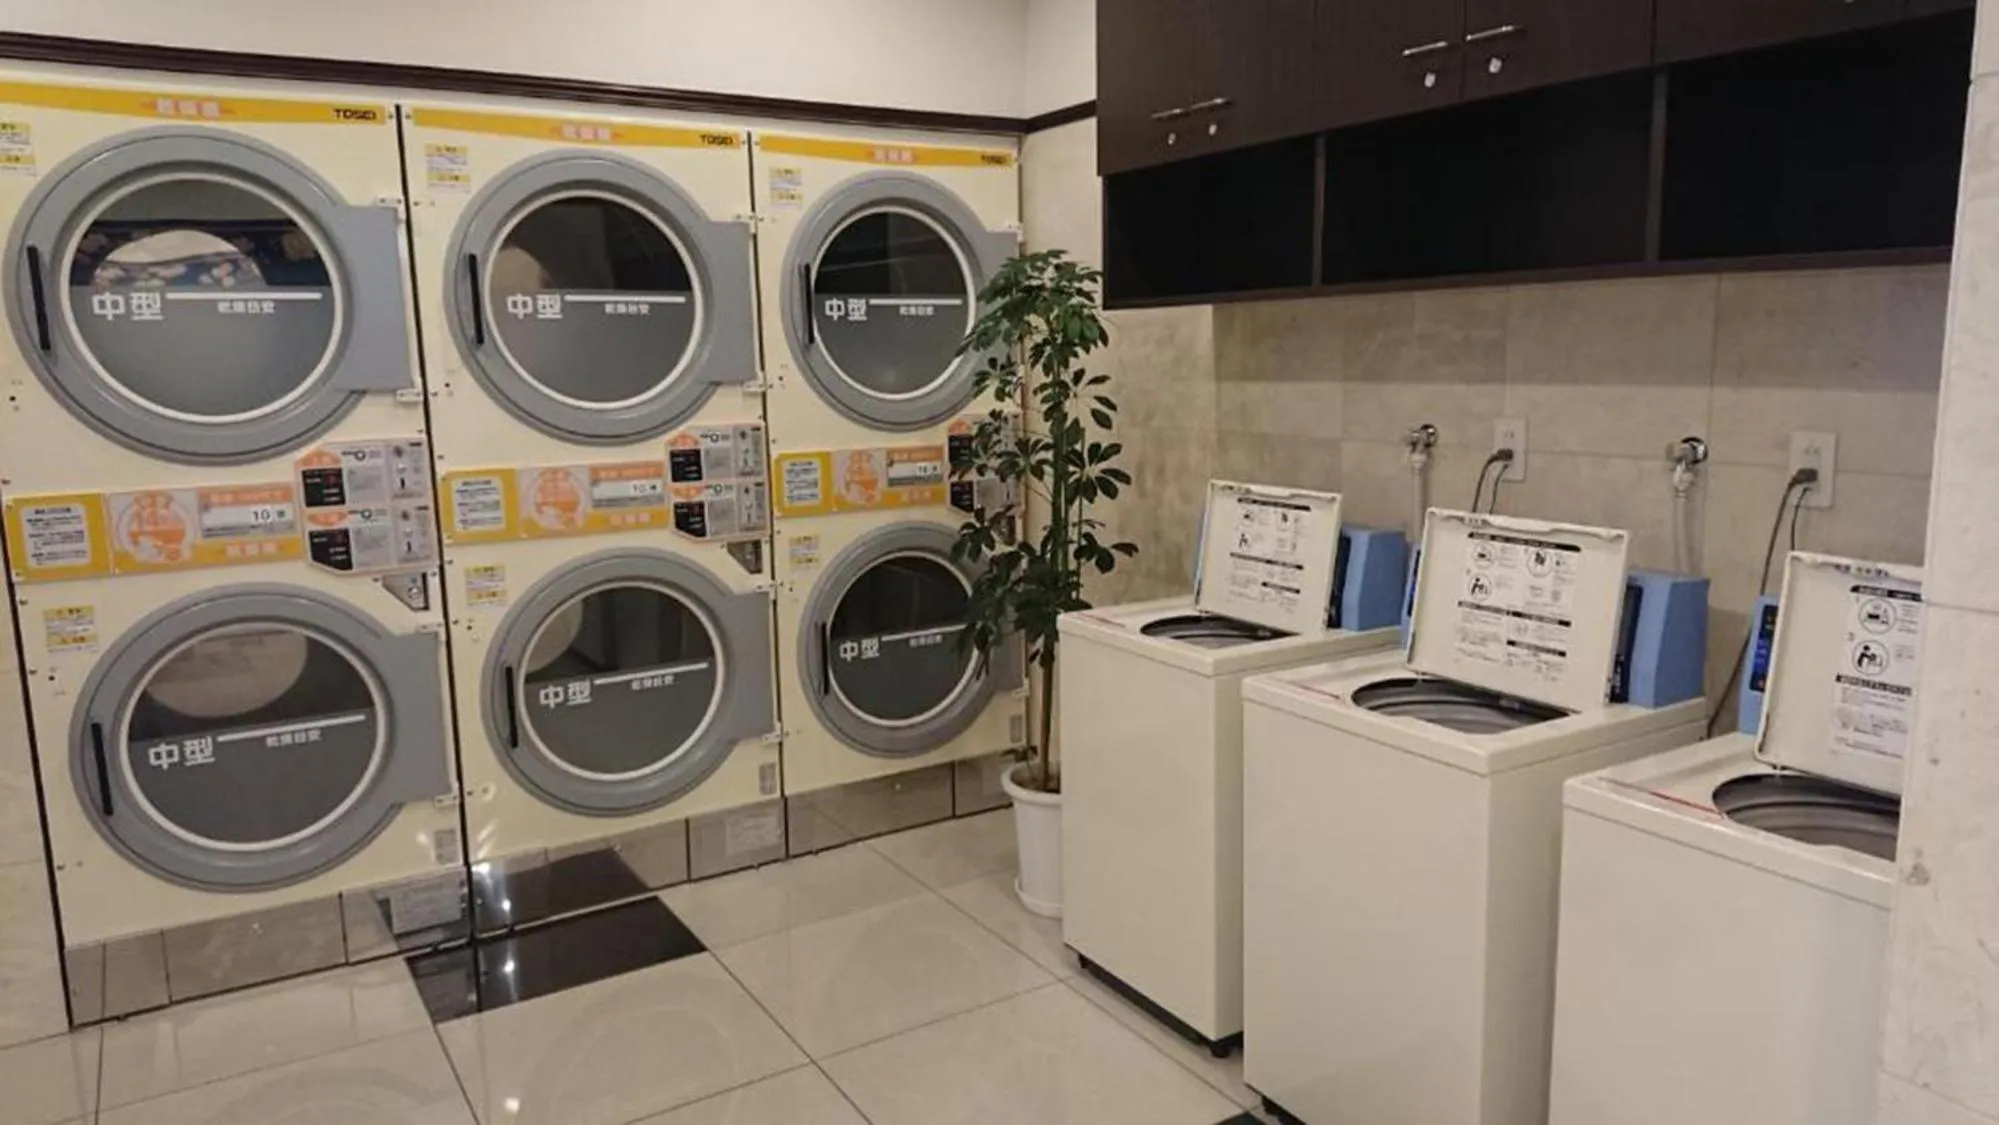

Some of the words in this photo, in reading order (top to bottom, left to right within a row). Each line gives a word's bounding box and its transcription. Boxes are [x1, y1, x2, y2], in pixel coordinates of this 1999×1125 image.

[92, 291, 164, 320] 中型
[506, 294, 563, 319] 中型
[825, 298, 867, 320] 中型
[839, 637, 880, 662] 中型
[539, 679, 592, 708] 中型
[148, 736, 216, 769] 中型
